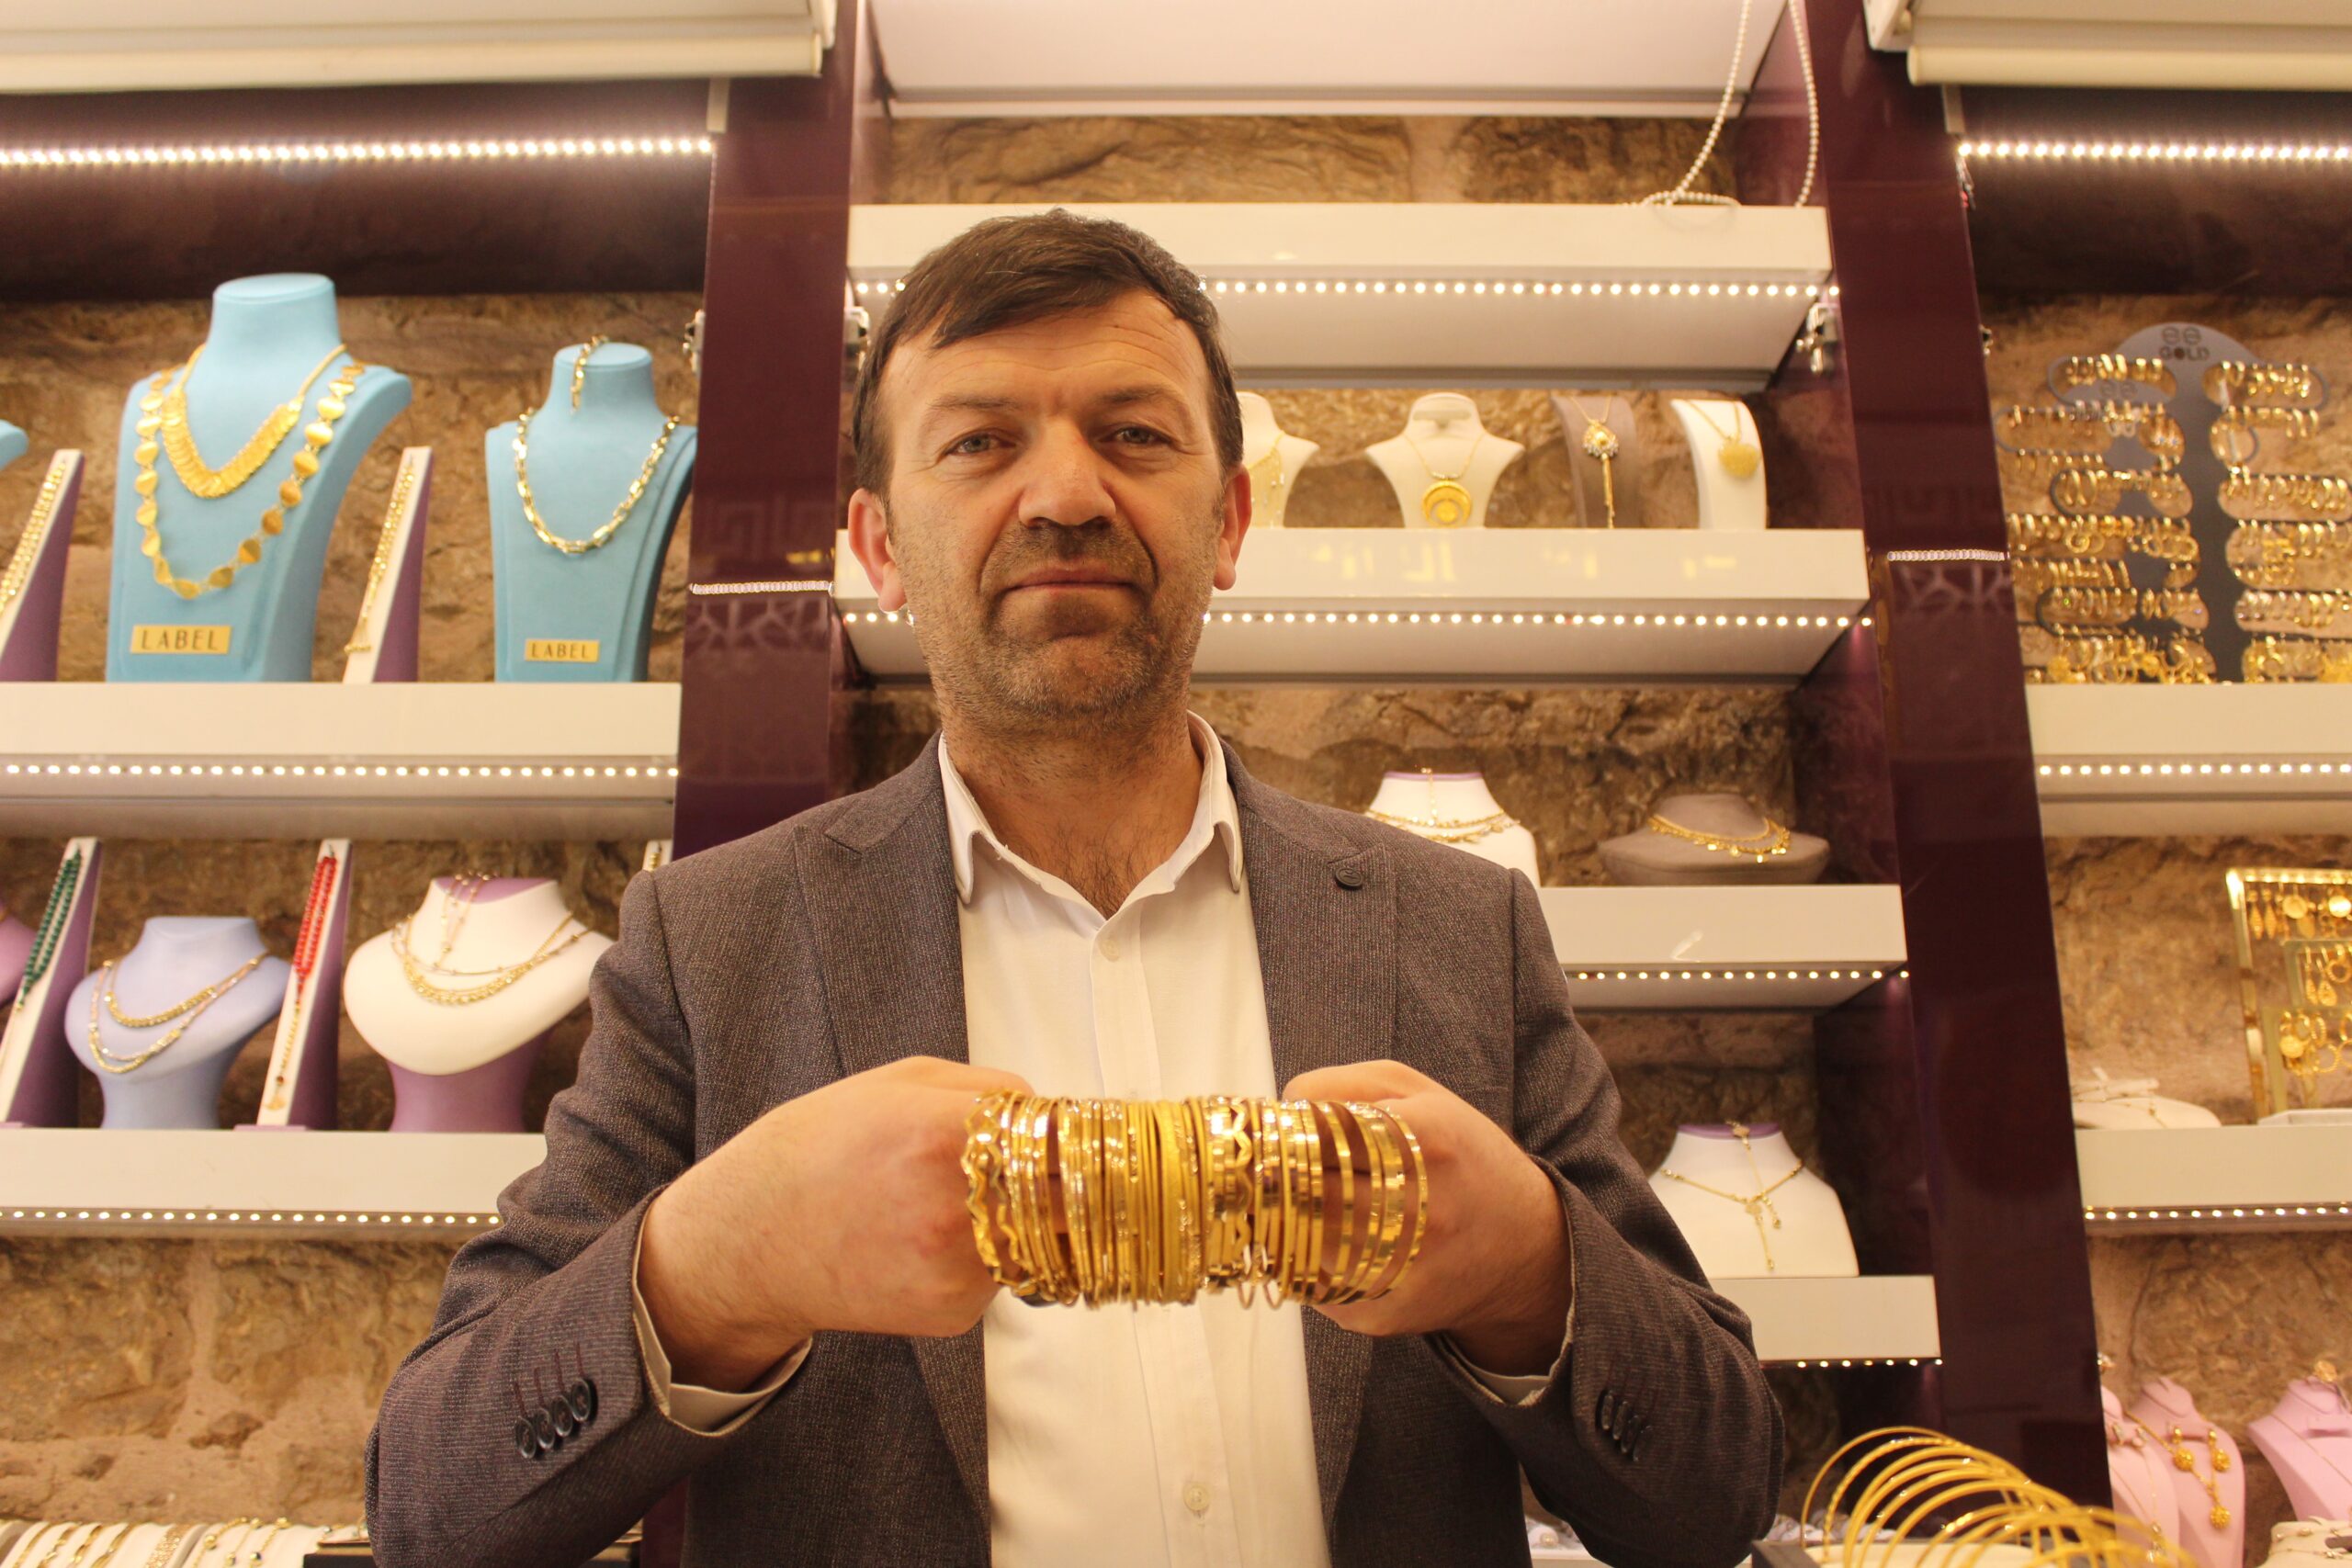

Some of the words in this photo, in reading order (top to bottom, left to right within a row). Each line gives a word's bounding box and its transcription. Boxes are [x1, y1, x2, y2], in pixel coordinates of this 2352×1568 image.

[2159, 346, 2210, 360] GOLD
[141, 629, 219, 650] LABEL
[531, 642, 590, 659] LABEL
